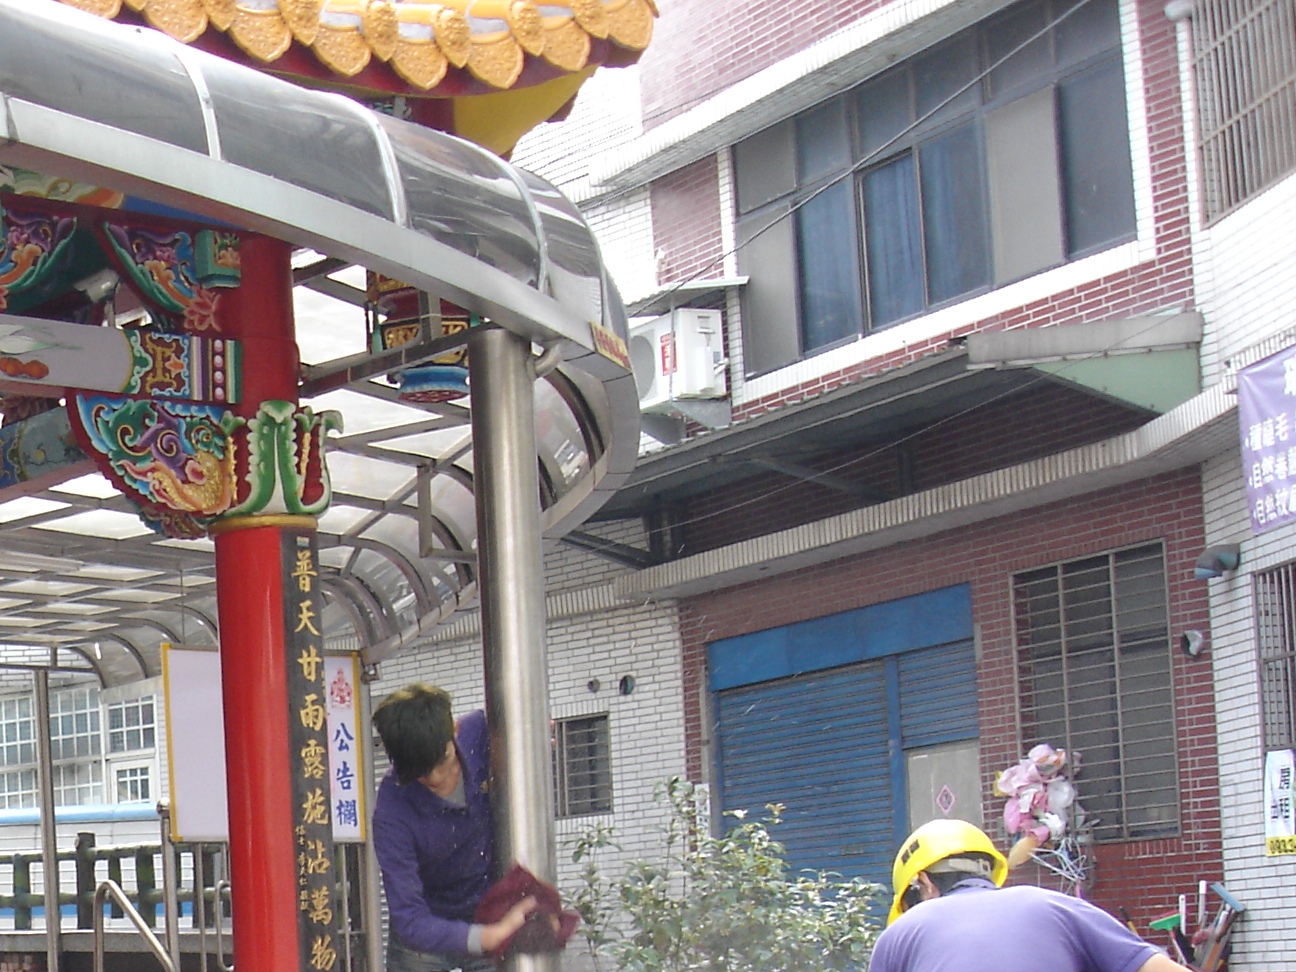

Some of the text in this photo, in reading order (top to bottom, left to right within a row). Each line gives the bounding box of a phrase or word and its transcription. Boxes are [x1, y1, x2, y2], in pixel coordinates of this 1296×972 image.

[291, 550, 337, 971] 普天甘雨露施沾萬物
[333, 722, 358, 827] 公告欄
